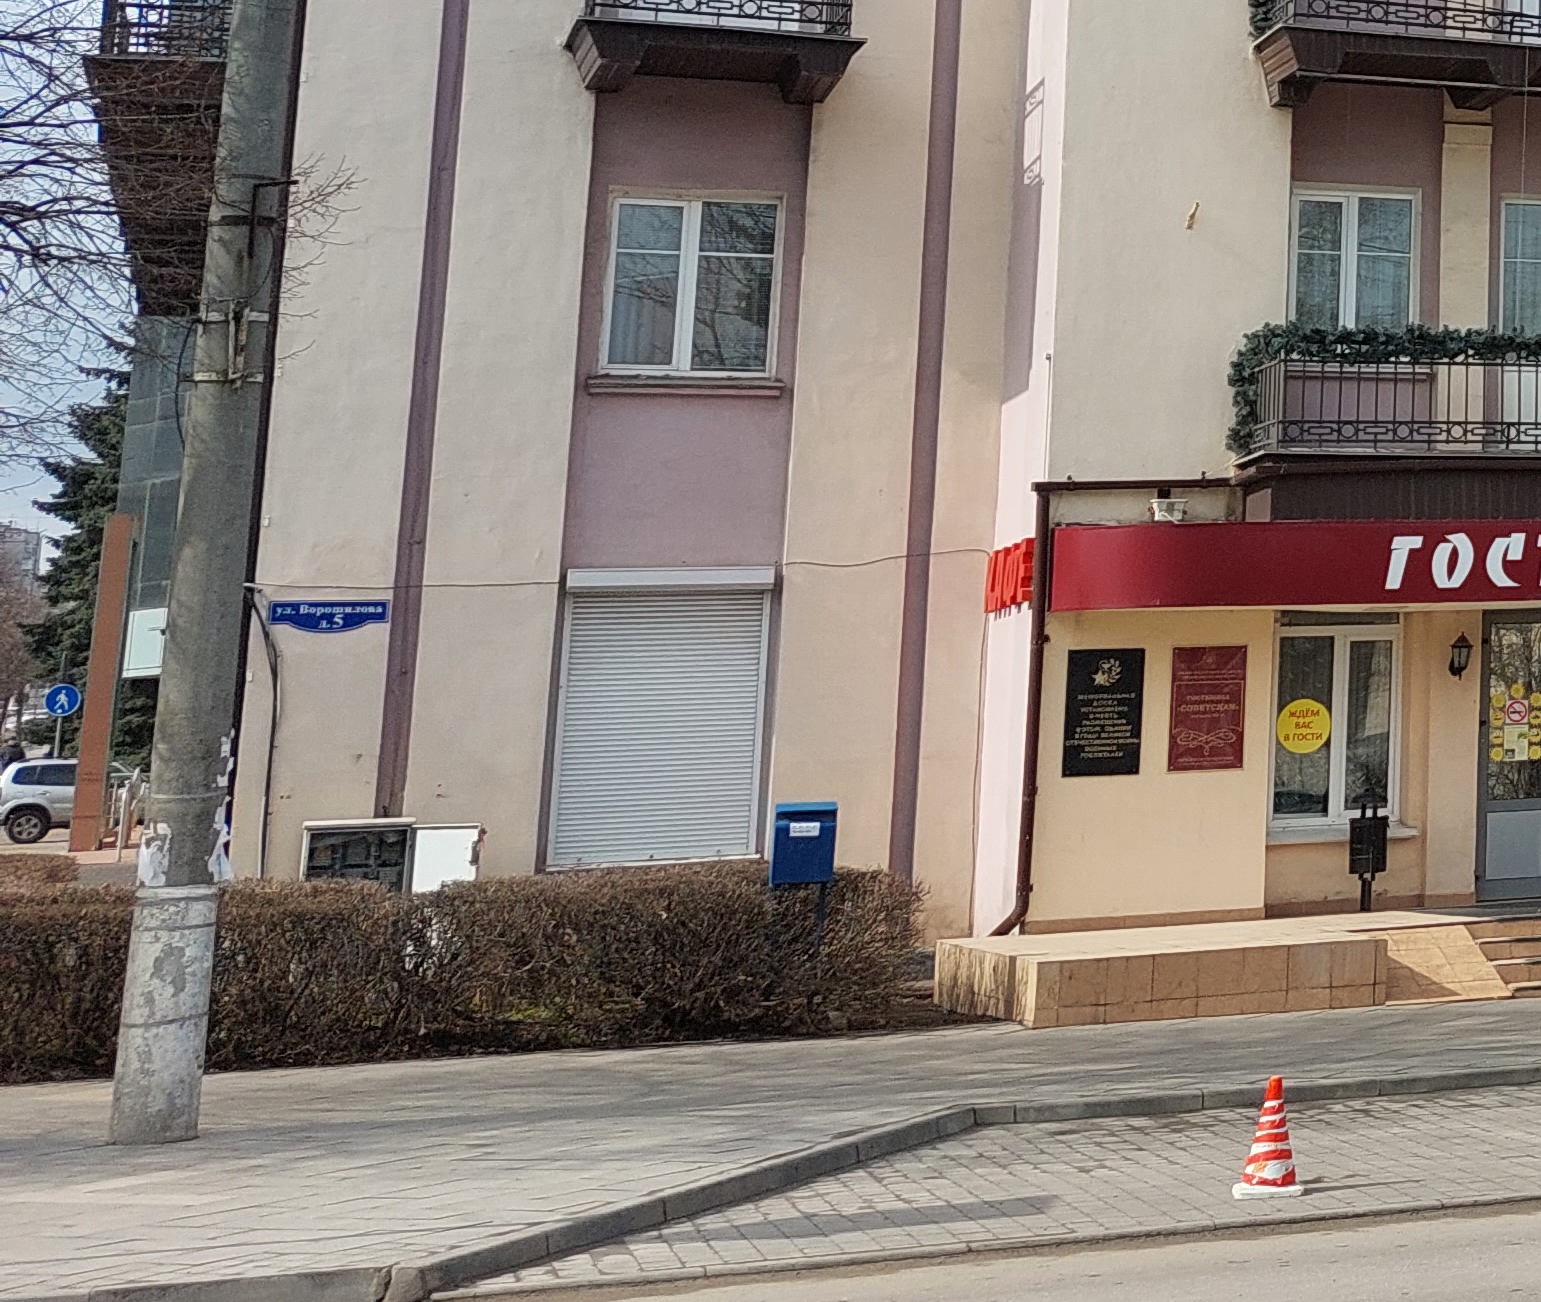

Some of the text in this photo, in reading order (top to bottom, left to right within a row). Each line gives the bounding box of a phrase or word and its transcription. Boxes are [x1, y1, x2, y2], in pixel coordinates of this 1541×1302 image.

[275, 604, 383, 617] ул. Ворошилова
[1288, 707, 1320, 719] ЖДЁМ
[1294, 721, 1314, 729] ВАС
[1292, 732, 1323, 741] ГОСТИ
